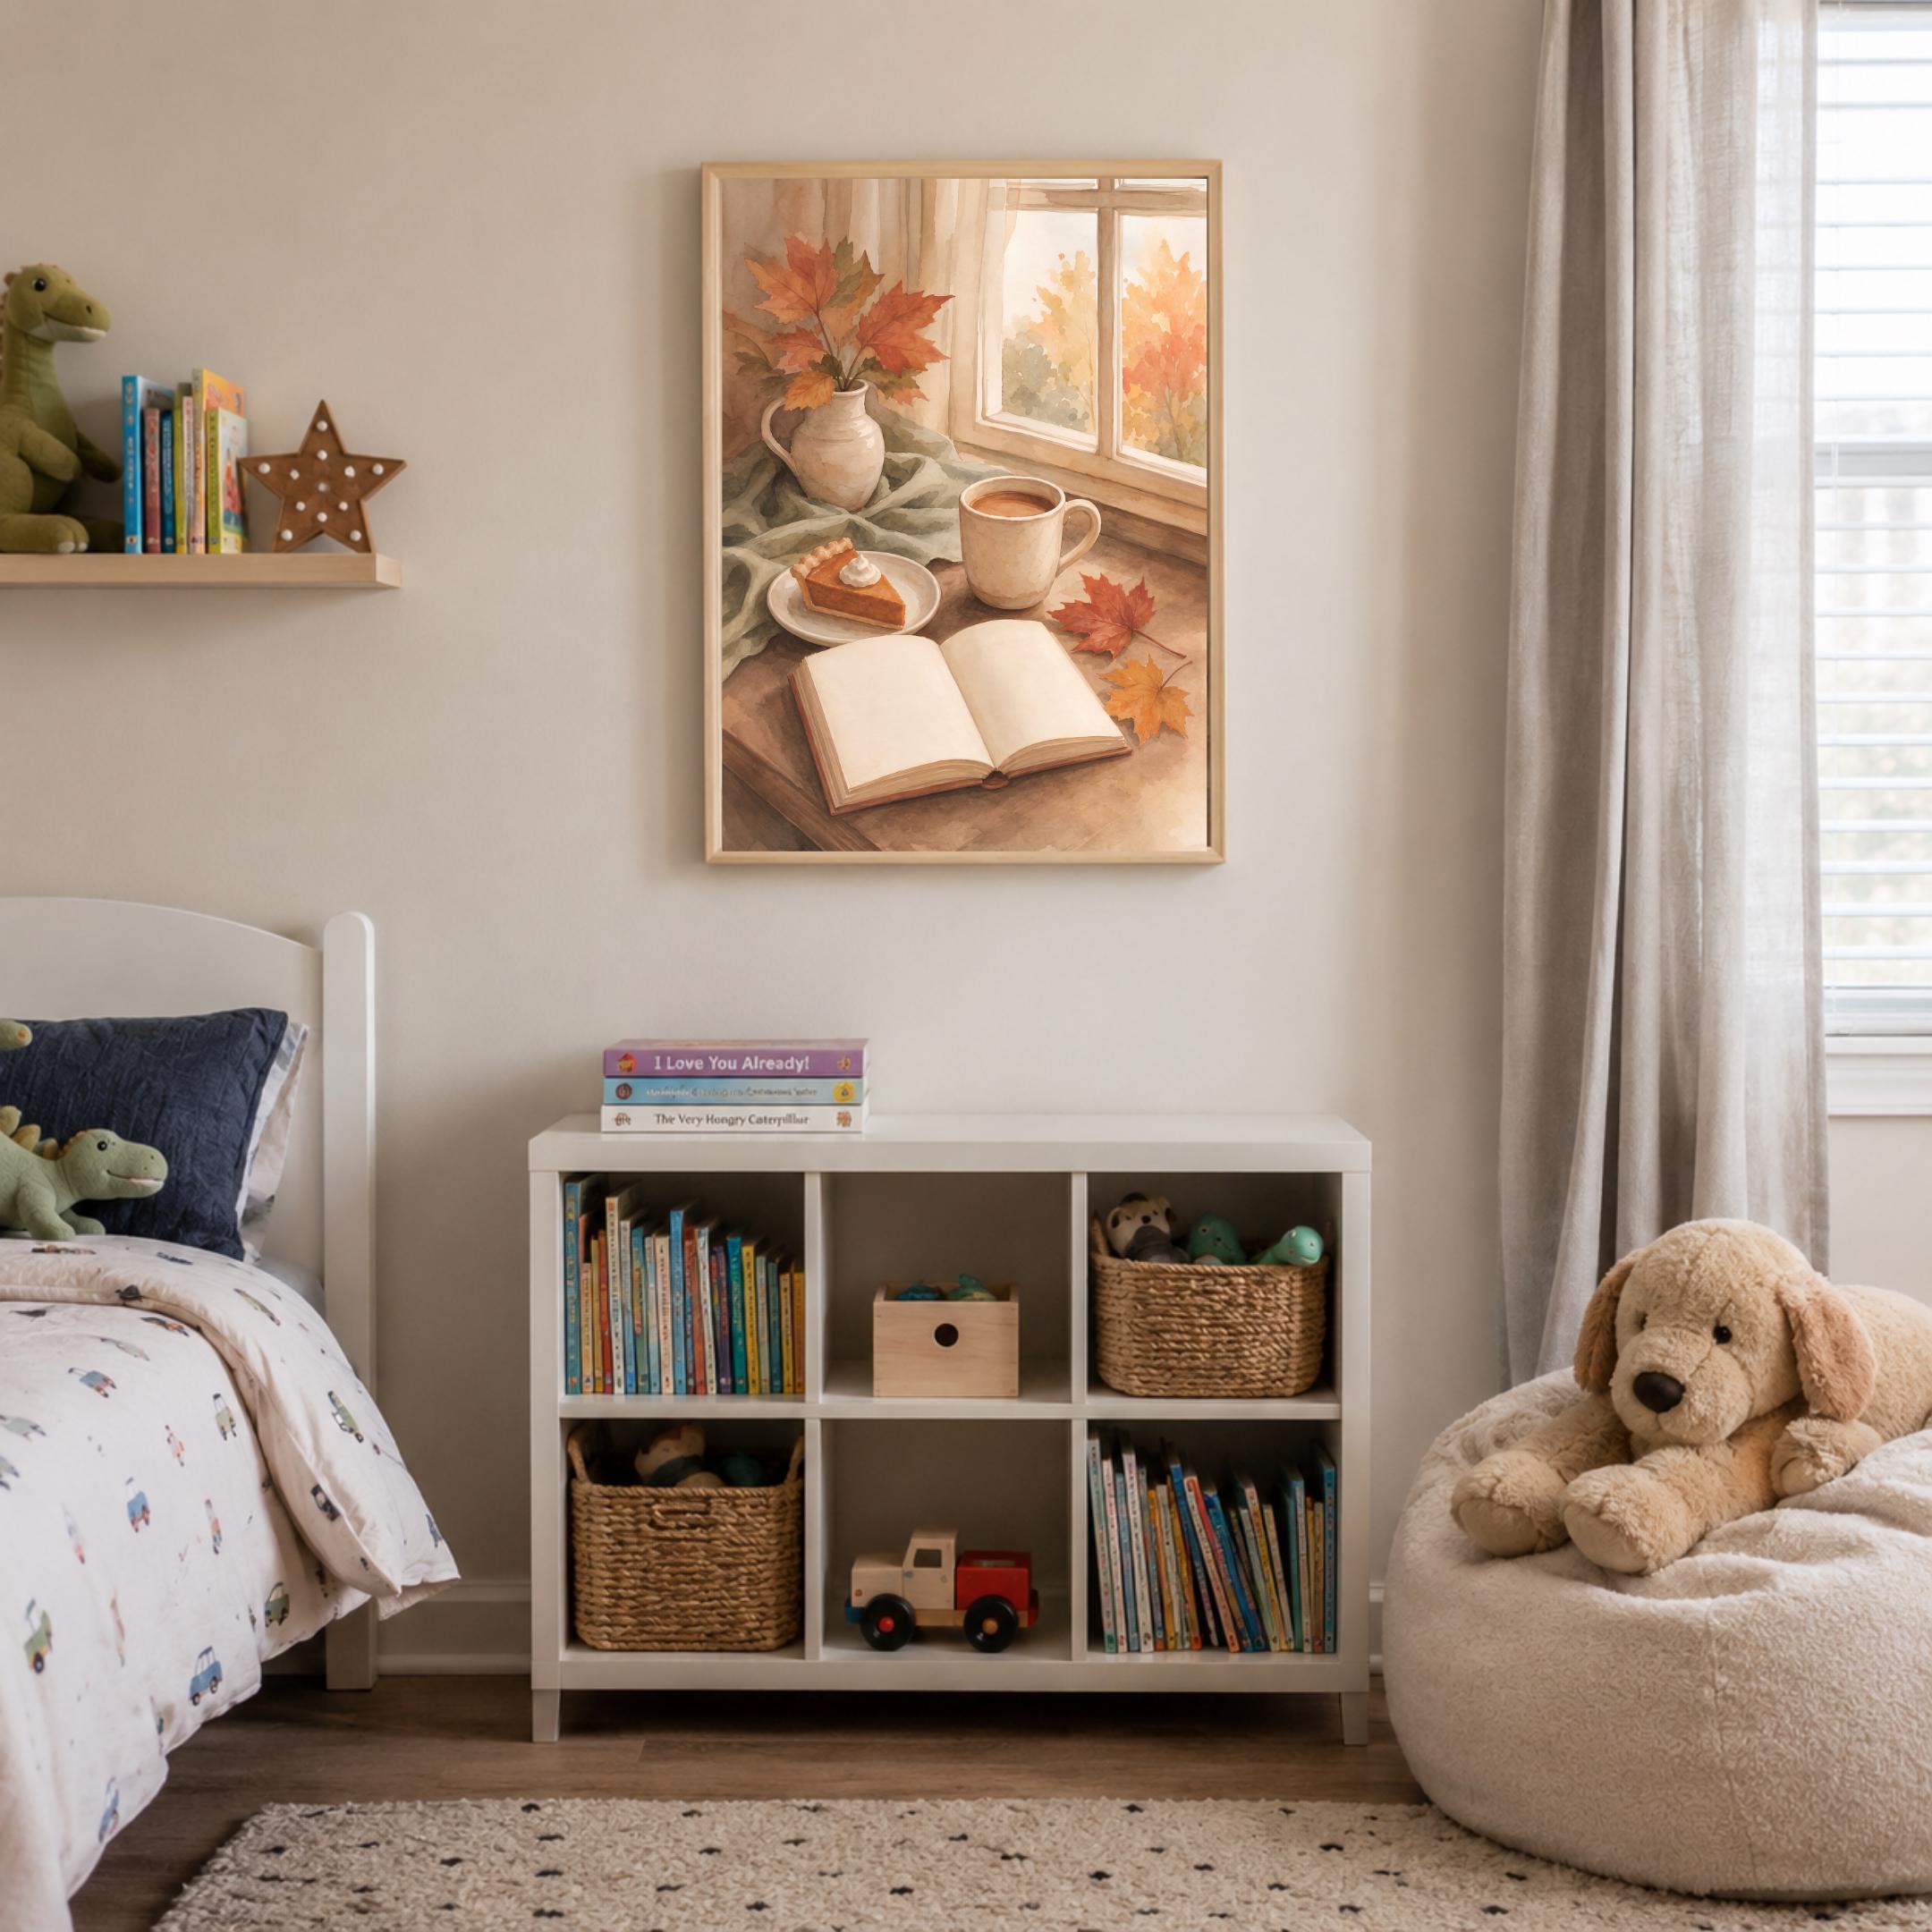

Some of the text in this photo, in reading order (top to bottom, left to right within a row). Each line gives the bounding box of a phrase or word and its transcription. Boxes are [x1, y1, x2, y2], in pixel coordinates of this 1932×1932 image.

[654, 1055, 809, 1073] I Love You Already!
[655, 1113, 675, 1125] The
[678, 1113, 703, 1127] Very
